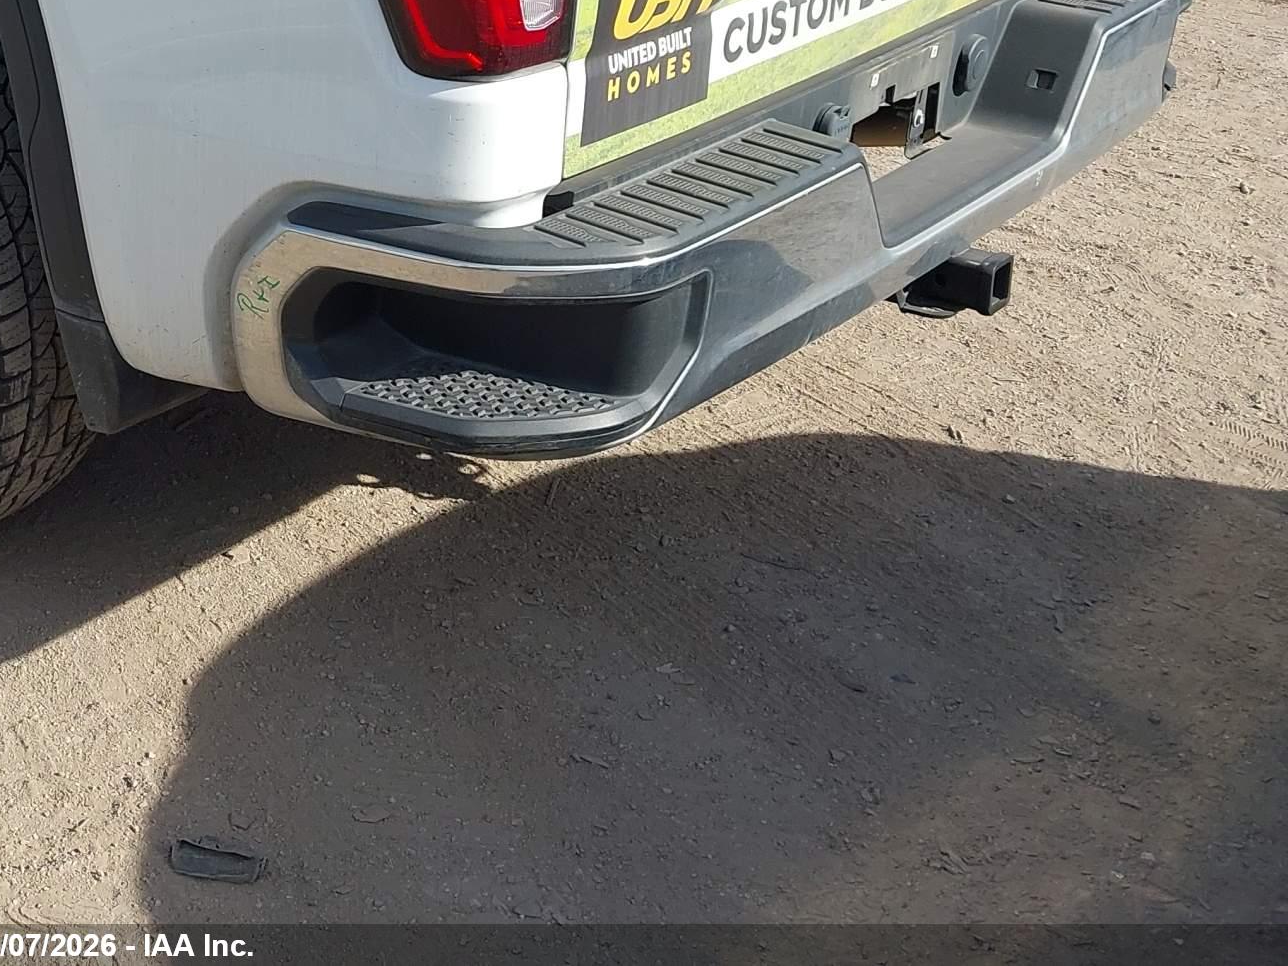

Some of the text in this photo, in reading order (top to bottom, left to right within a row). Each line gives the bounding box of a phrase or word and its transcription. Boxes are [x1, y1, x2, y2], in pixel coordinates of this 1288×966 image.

[608, 26, 693, 75] UNITED BUILT
[607, 51, 692, 102] HOMES
